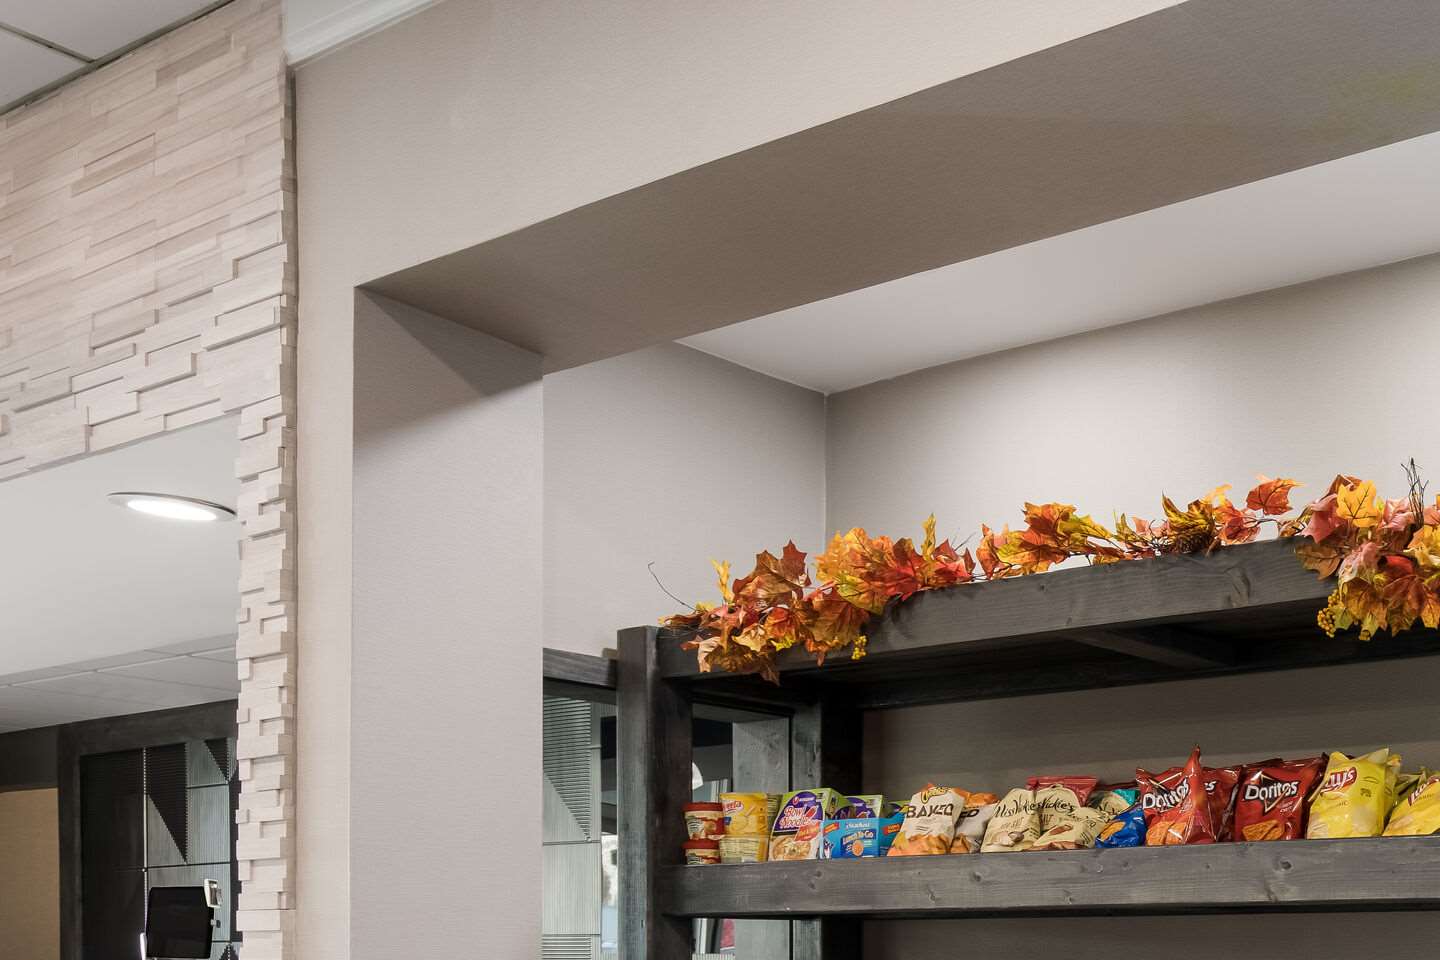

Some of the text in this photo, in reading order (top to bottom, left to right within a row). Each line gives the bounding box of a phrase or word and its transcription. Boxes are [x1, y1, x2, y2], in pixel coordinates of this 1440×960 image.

[1142, 778, 1190, 810] Doritos
[1244, 780, 1299, 800] Doritos
[906, 803, 954, 819] BAKED
